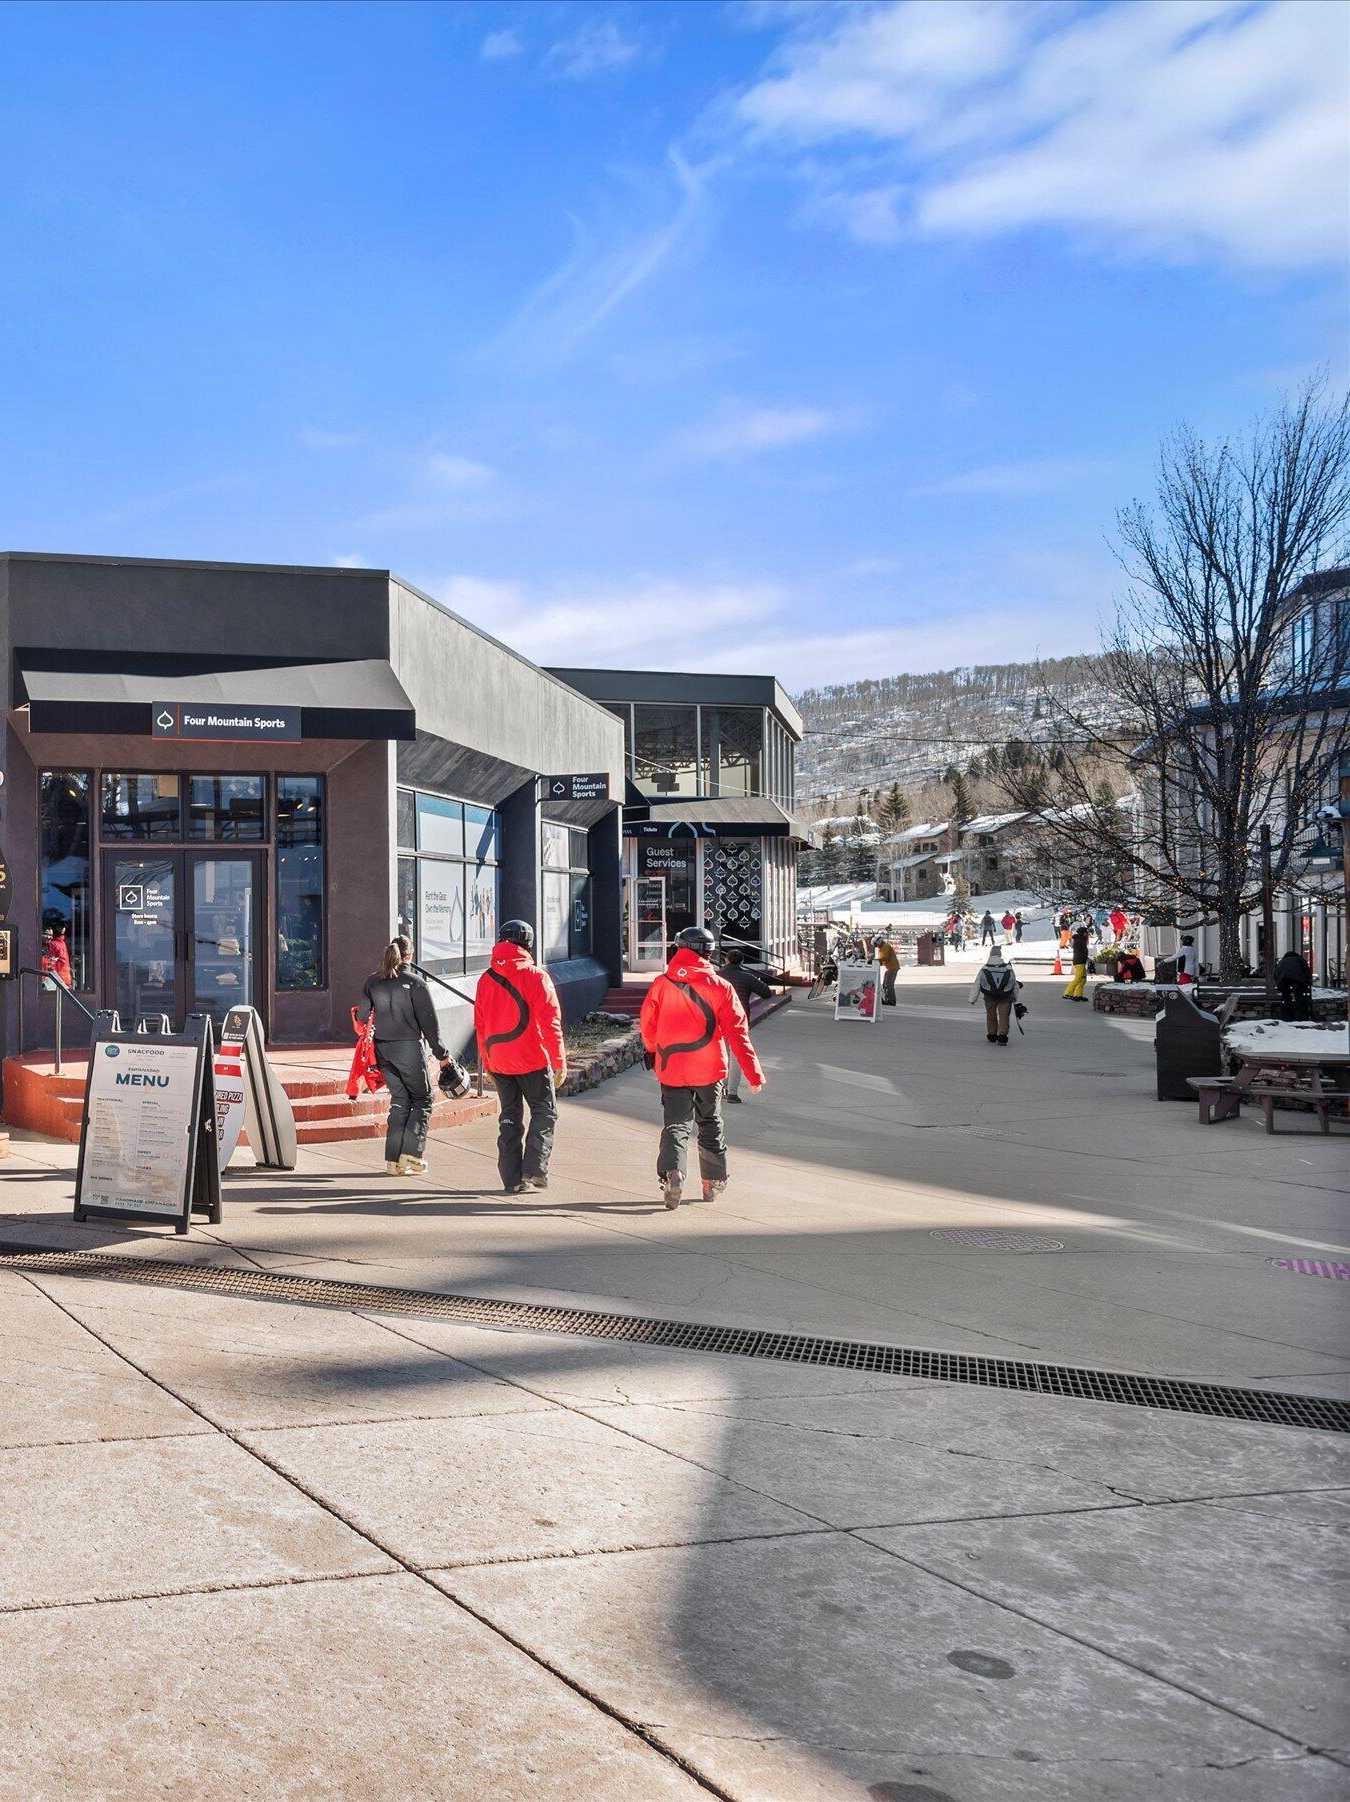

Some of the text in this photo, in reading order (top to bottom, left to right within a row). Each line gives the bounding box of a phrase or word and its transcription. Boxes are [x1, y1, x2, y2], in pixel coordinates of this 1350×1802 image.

[184, 715, 286, 730] Four Mountain Sports
[572, 791, 596, 799] Sports
[646, 847, 674, 857] Guest
[646, 858, 687, 868] Services
[127, 1048, 165, 1056] SNACFOOD
[115, 1073, 170, 1088] MENU
